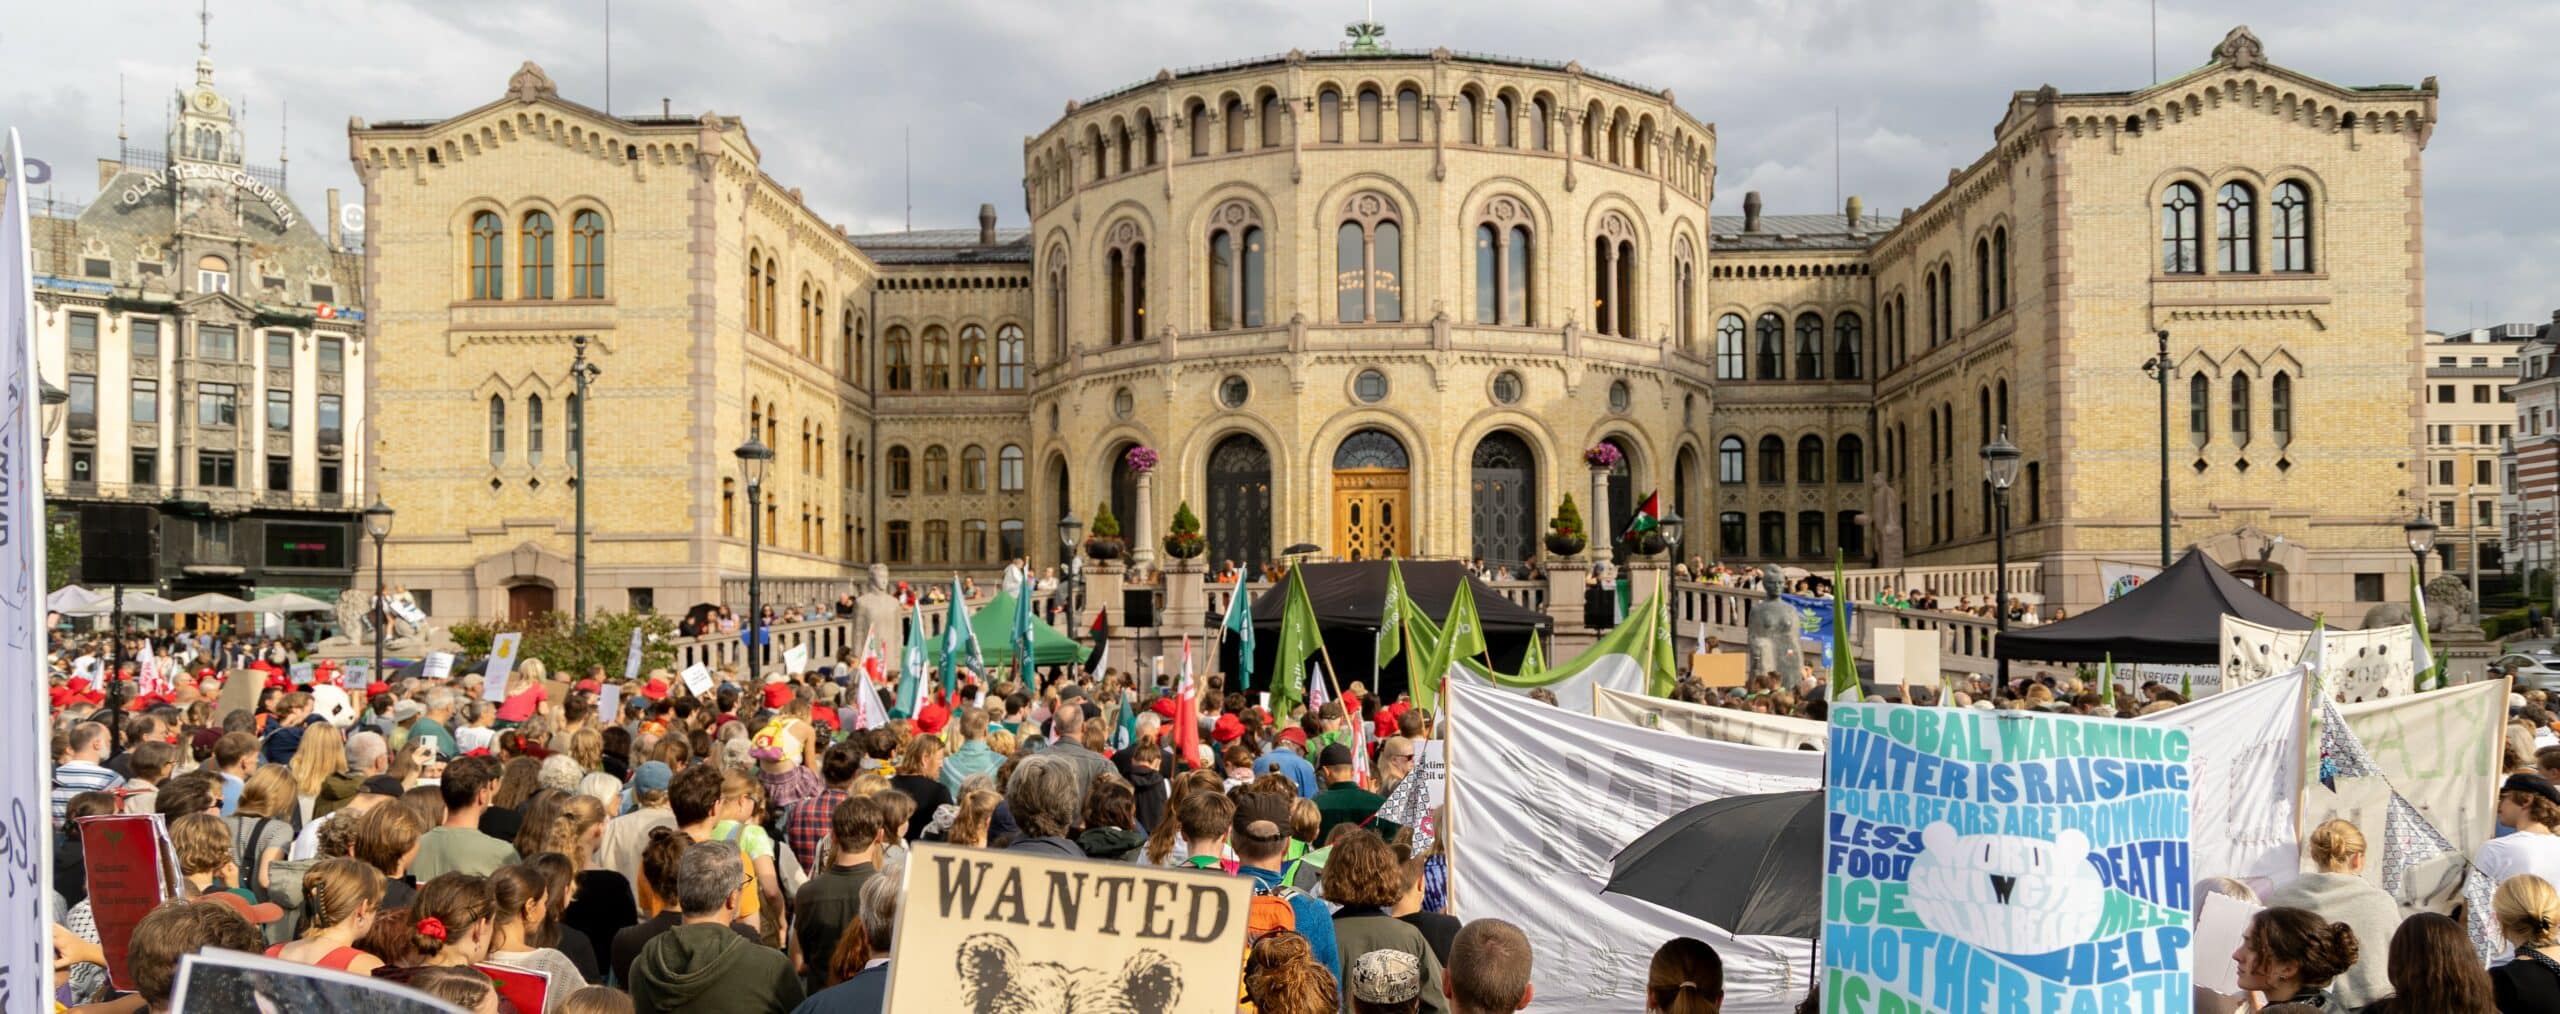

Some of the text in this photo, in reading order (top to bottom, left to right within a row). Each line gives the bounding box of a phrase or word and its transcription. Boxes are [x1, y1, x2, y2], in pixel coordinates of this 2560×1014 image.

[123, 162, 297, 229] OLAV THON GRUPPEN
[1833, 706, 1993, 763] GLOBAL
[1998, 717, 2190, 763] WARMING
[1831, 727, 1969, 800] WATER
[1976, 763, 2019, 803] IS
[2020, 757, 2190, 804] RAISING
[1829, 787, 2189, 850] POLAR BEARS ARE DROWNING
[1829, 812, 1926, 854] LESS
[1828, 844, 1917, 882] FOOD
[2086, 840, 2191, 911] DEATH
[932, 855, 1230, 944] WANTED
[1826, 876, 1928, 929] ICE
[2088, 888, 2190, 941] MELT
[1826, 923, 2030, 1014] MOTHER
[1990, 926, 2191, 986] HELP
